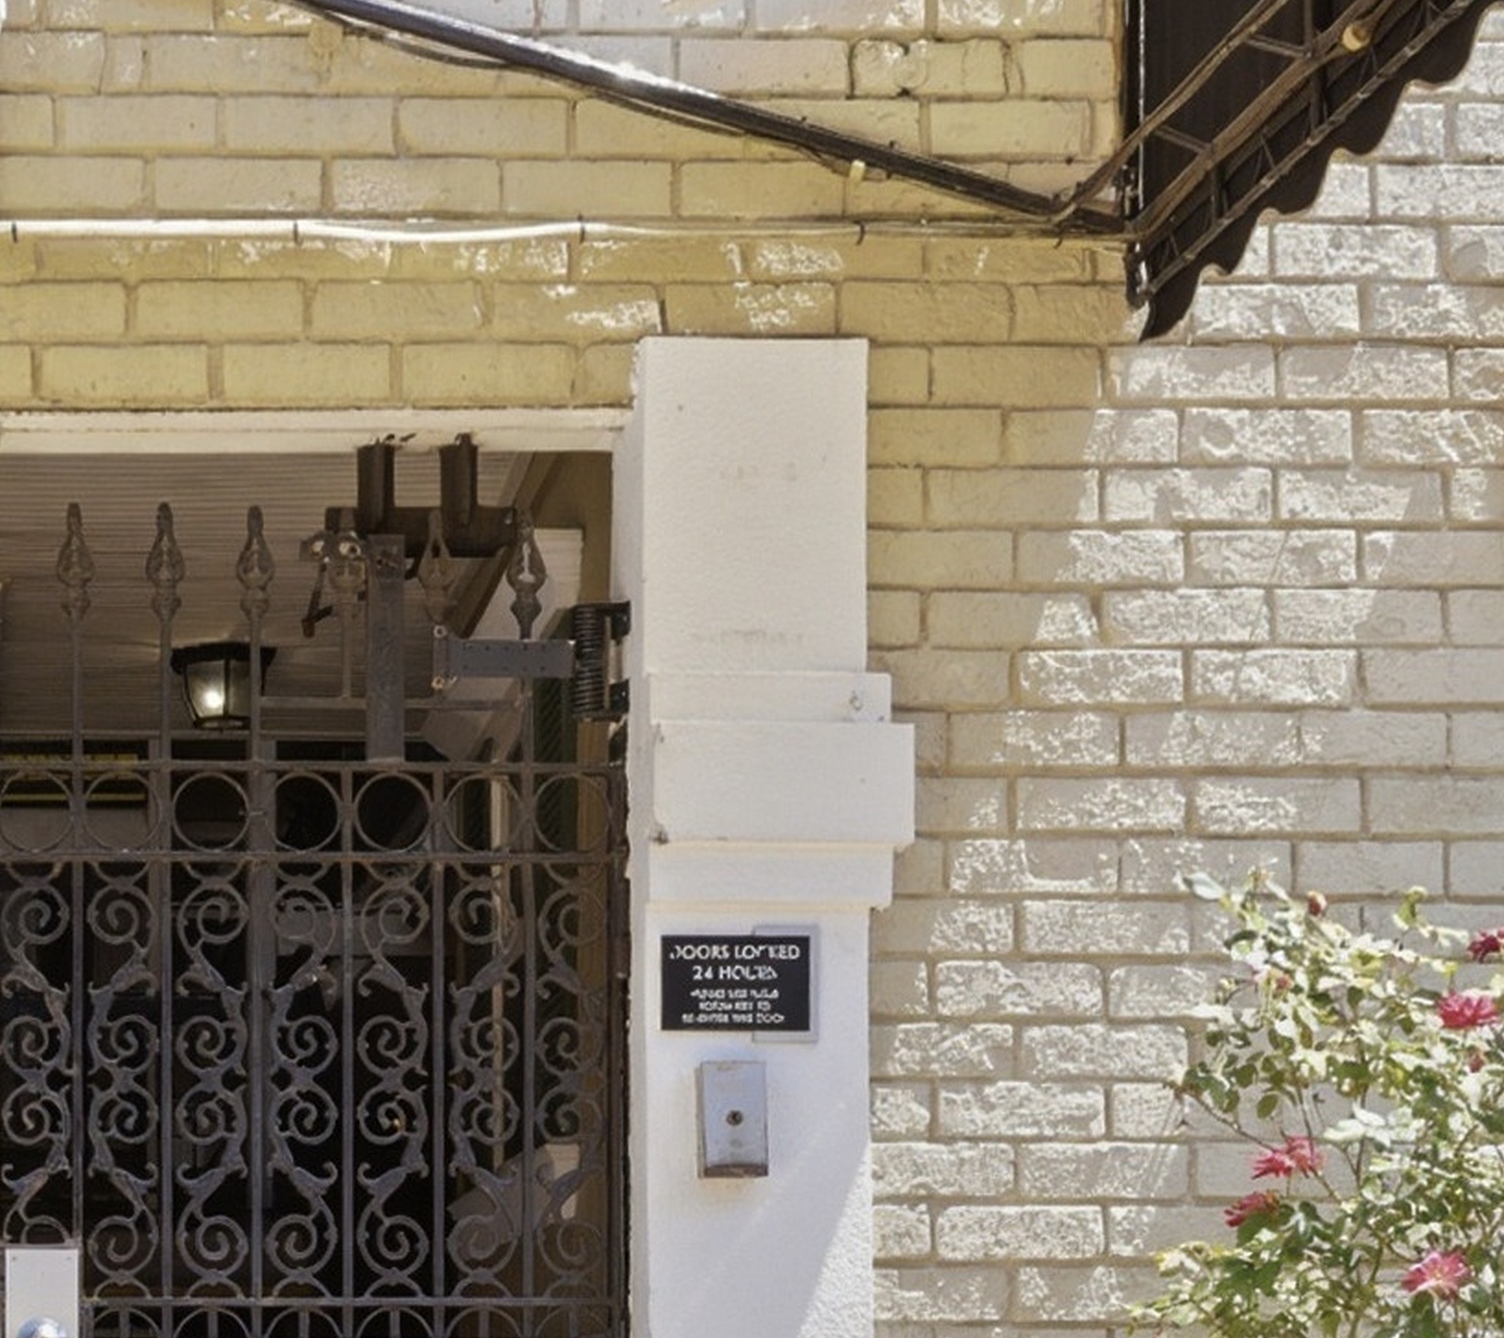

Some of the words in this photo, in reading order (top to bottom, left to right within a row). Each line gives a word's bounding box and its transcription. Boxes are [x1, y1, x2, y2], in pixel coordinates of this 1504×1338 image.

[669, 944, 731, 960] DOORS
[734, 944, 801, 960] LOCKED
[692, 964, 713, 981] 24
